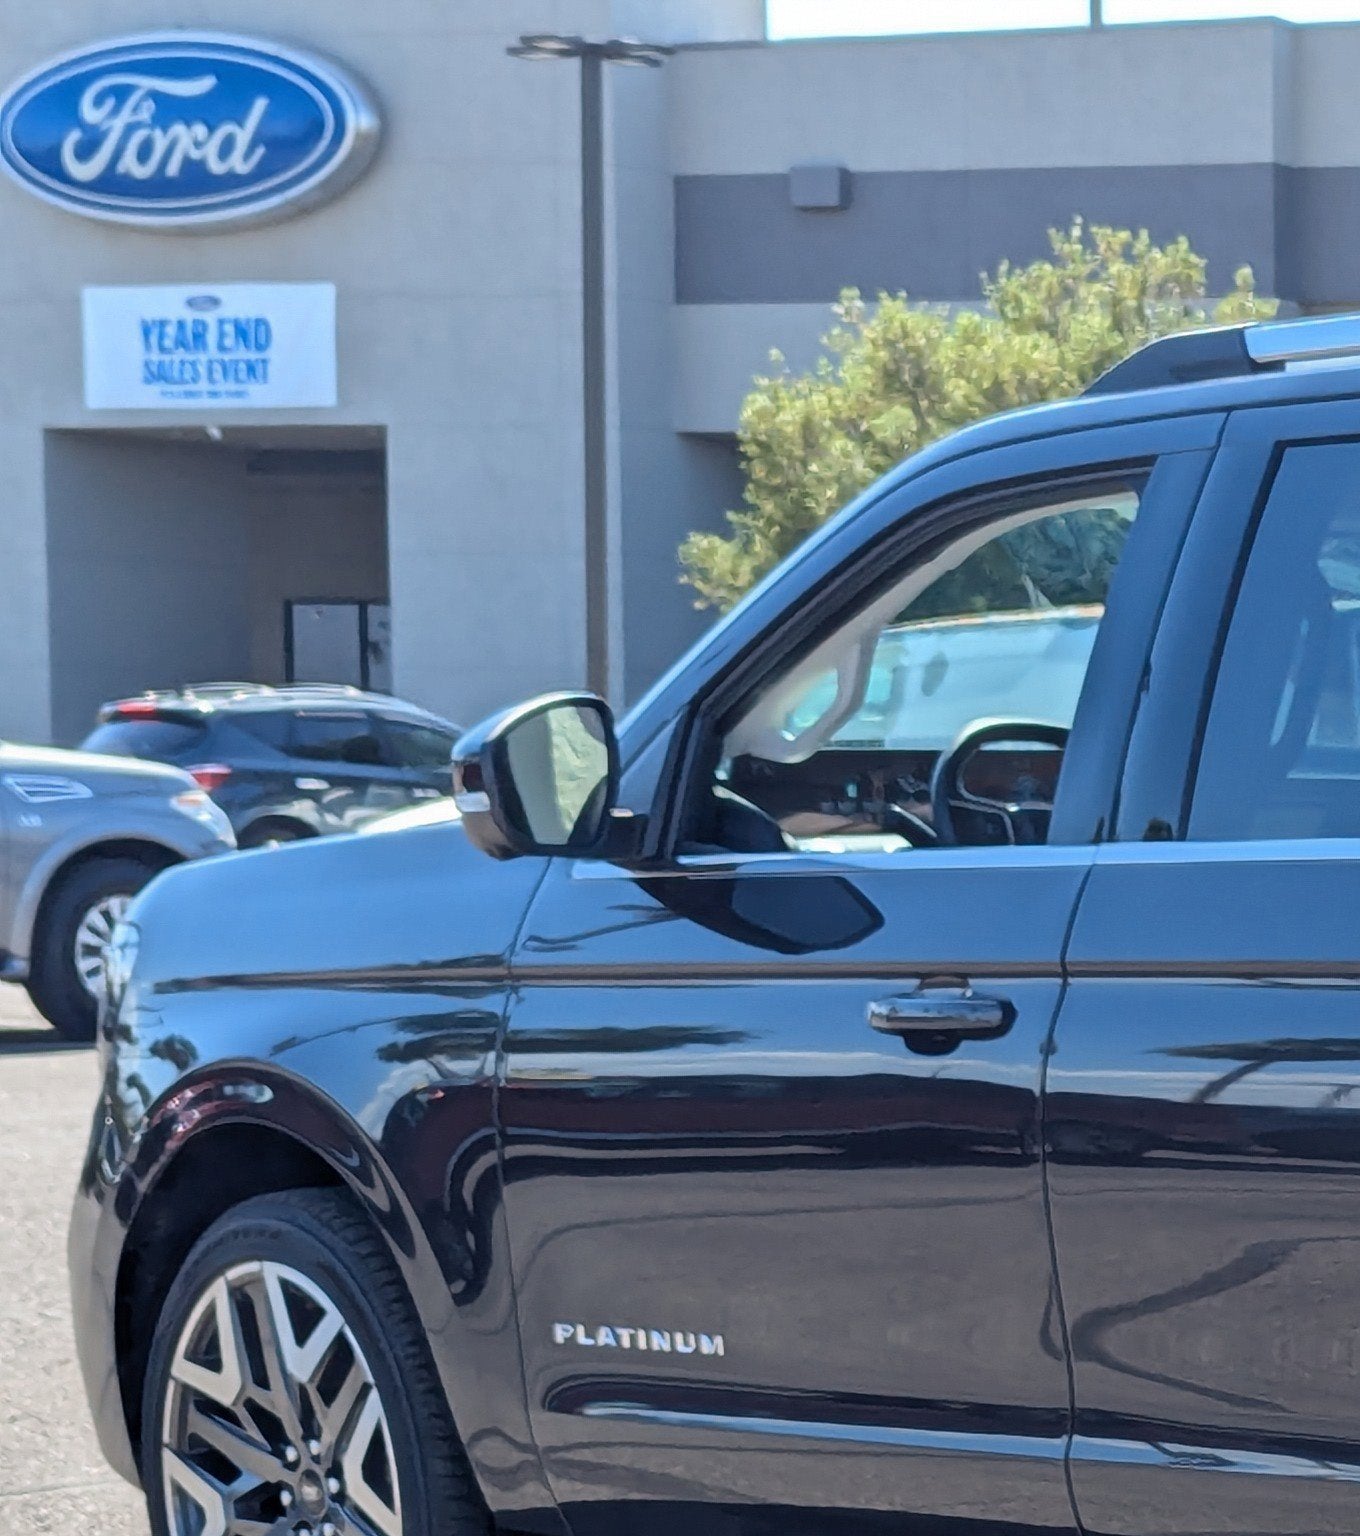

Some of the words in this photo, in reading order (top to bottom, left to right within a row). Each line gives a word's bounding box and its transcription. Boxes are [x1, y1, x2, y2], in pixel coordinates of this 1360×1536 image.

[61, 73, 270, 182] Ford
[140, 317, 209, 354] YEAR
[216, 317, 273, 354] END
[142, 358, 201, 386] SALES
[206, 357, 269, 386] EVENT
[553, 1322, 725, 1357] PLATINUM
